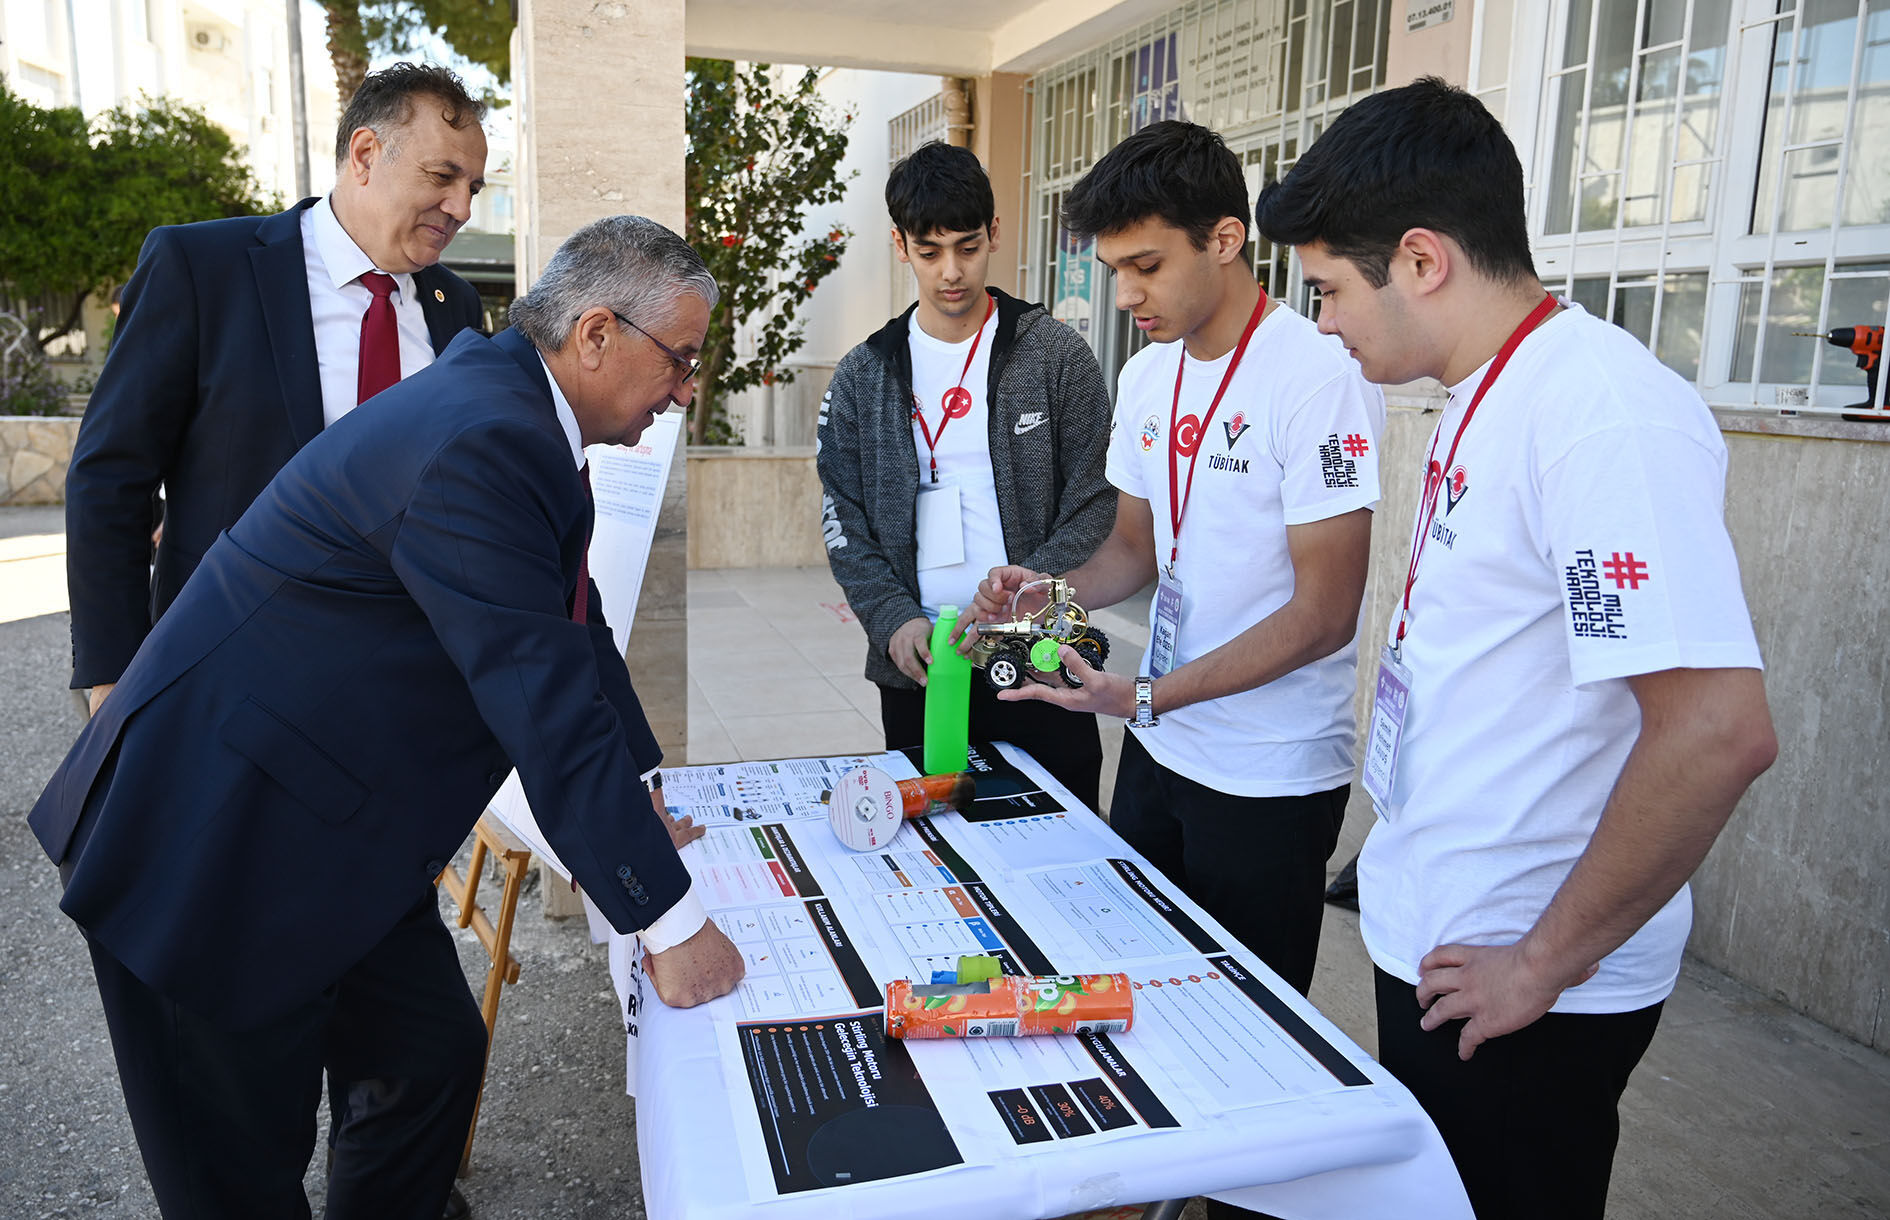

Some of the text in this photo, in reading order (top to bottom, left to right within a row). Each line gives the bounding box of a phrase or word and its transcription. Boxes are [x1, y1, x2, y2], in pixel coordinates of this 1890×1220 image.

[1208, 454, 1249, 473] TÜBİTAK
[1318, 444, 1337, 488] HAMLESİ
[1328, 433, 1348, 488] TEKNOLOJİ
[1344, 460, 1359, 488] MİLLİ
[1431, 518, 1457, 550] ÜBİTAK
[1565, 566, 1589, 637] HAMLESİ
[1575, 549, 1607, 638] TEKNOLOJİ
[1602, 594, 1627, 639] MİLLİ
[834, 1022, 857, 1061] Geleceğin
[850, 1061, 879, 1108] Teknolojisi
[849, 1020, 868, 1049] Stirling
[862, 1049, 882, 1080] Motoru
[1057, 1101, 1076, 1117] 30%
[1099, 1095, 1116, 1110] 40%
